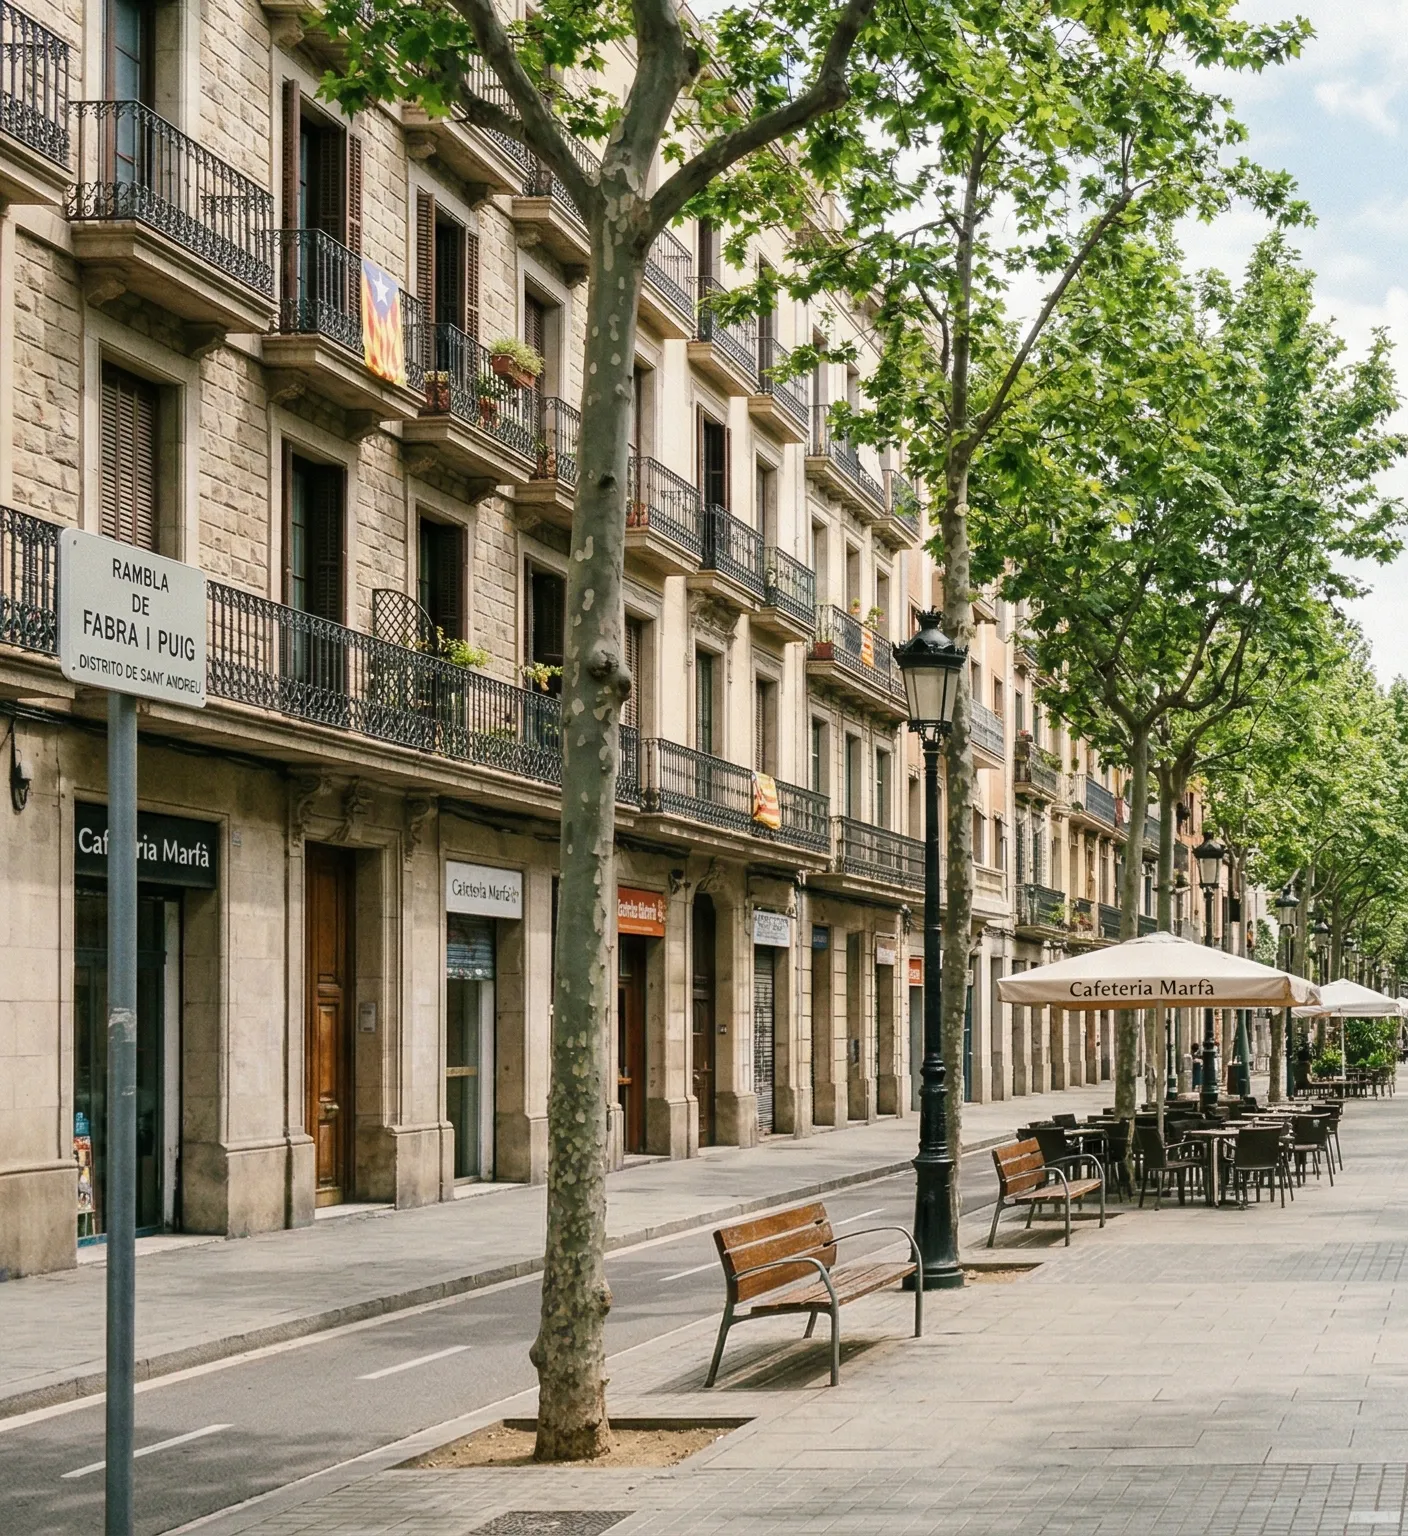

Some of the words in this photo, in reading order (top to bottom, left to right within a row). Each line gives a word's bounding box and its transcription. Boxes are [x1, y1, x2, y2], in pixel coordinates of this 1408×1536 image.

[112, 557, 170, 593] RAMBLA
[131, 593, 150, 617] DE
[83, 609, 139, 648] FABRA
[146, 626, 150, 651] I
[158, 629, 195, 662] PUIG
[79, 653, 124, 677] DISTRITO
[125, 664, 138, 681] DE
[165, 673, 202, 695] ANDREU
[78, 827, 158, 861] Cafria
[163, 838, 210, 868] Marfà
[1069, 979, 1153, 997] Cafeteria
